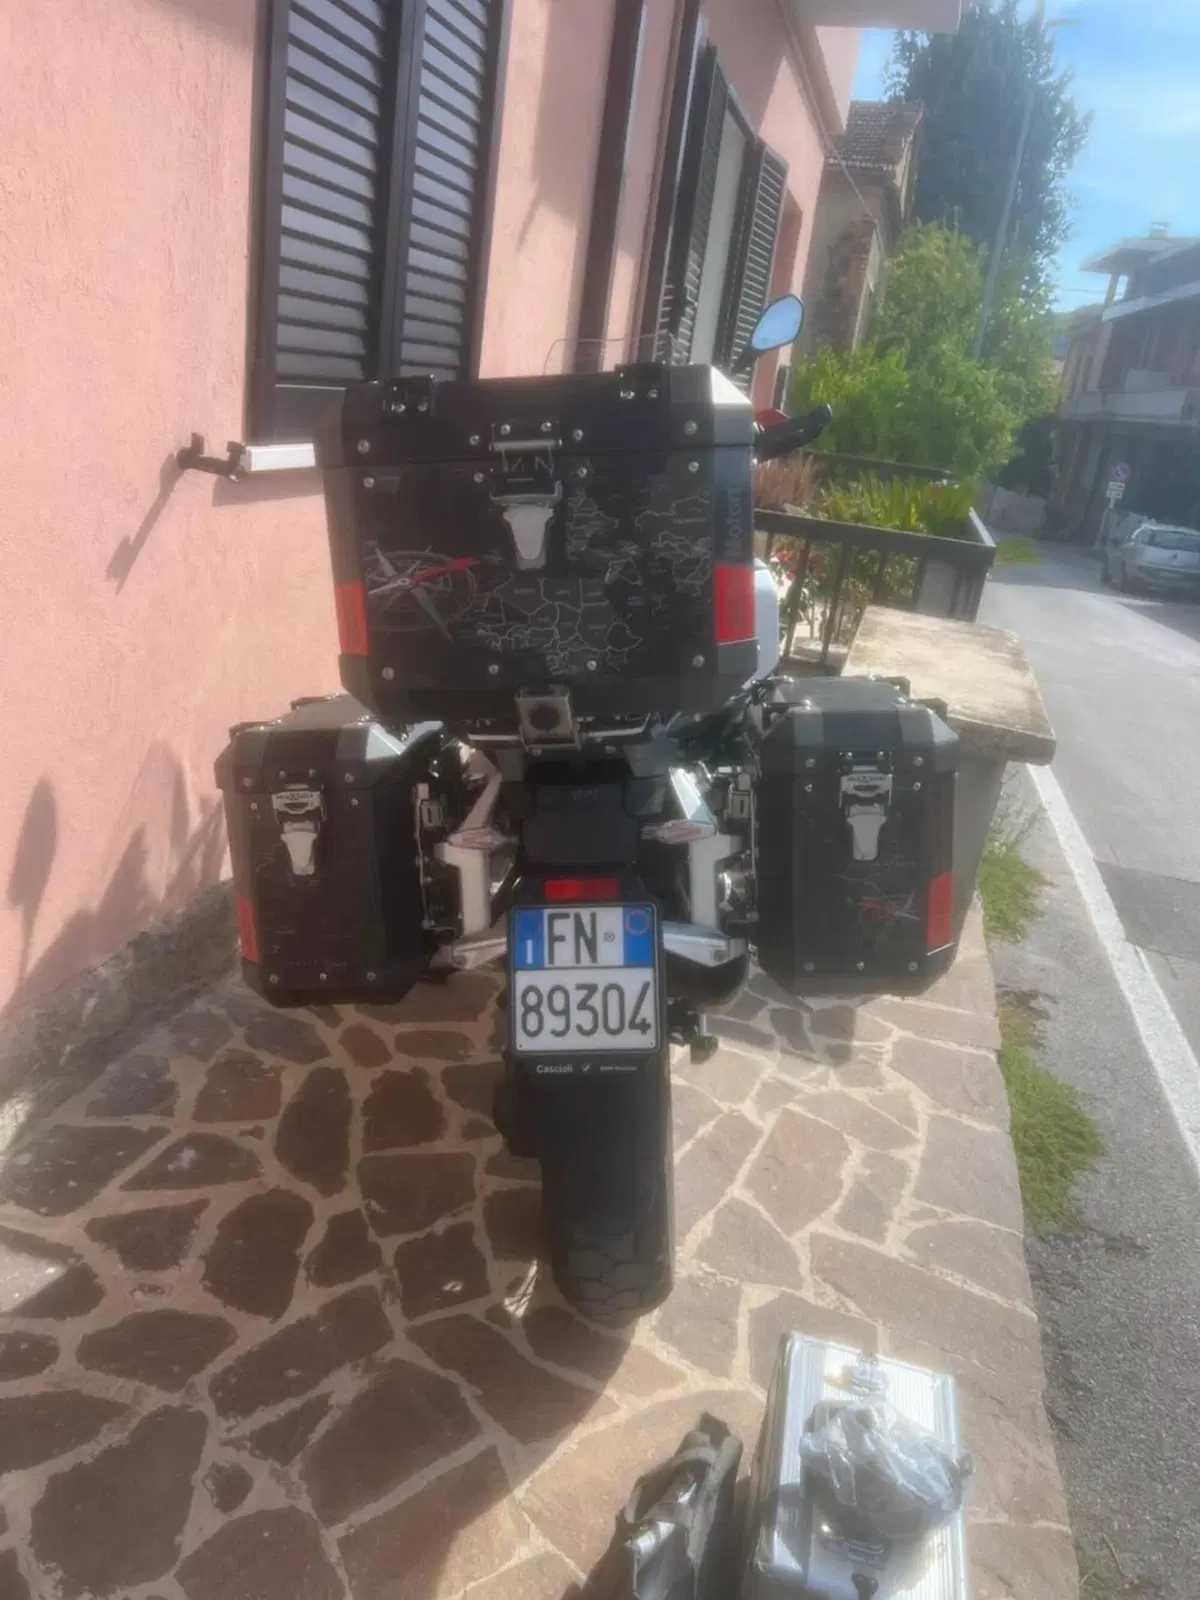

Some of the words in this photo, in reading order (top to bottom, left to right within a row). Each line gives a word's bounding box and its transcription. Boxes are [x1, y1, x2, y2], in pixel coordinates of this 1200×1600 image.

[526, 939, 534, 965] I
[547, 912, 598, 965] FN
[520, 981, 652, 1038] 89304
